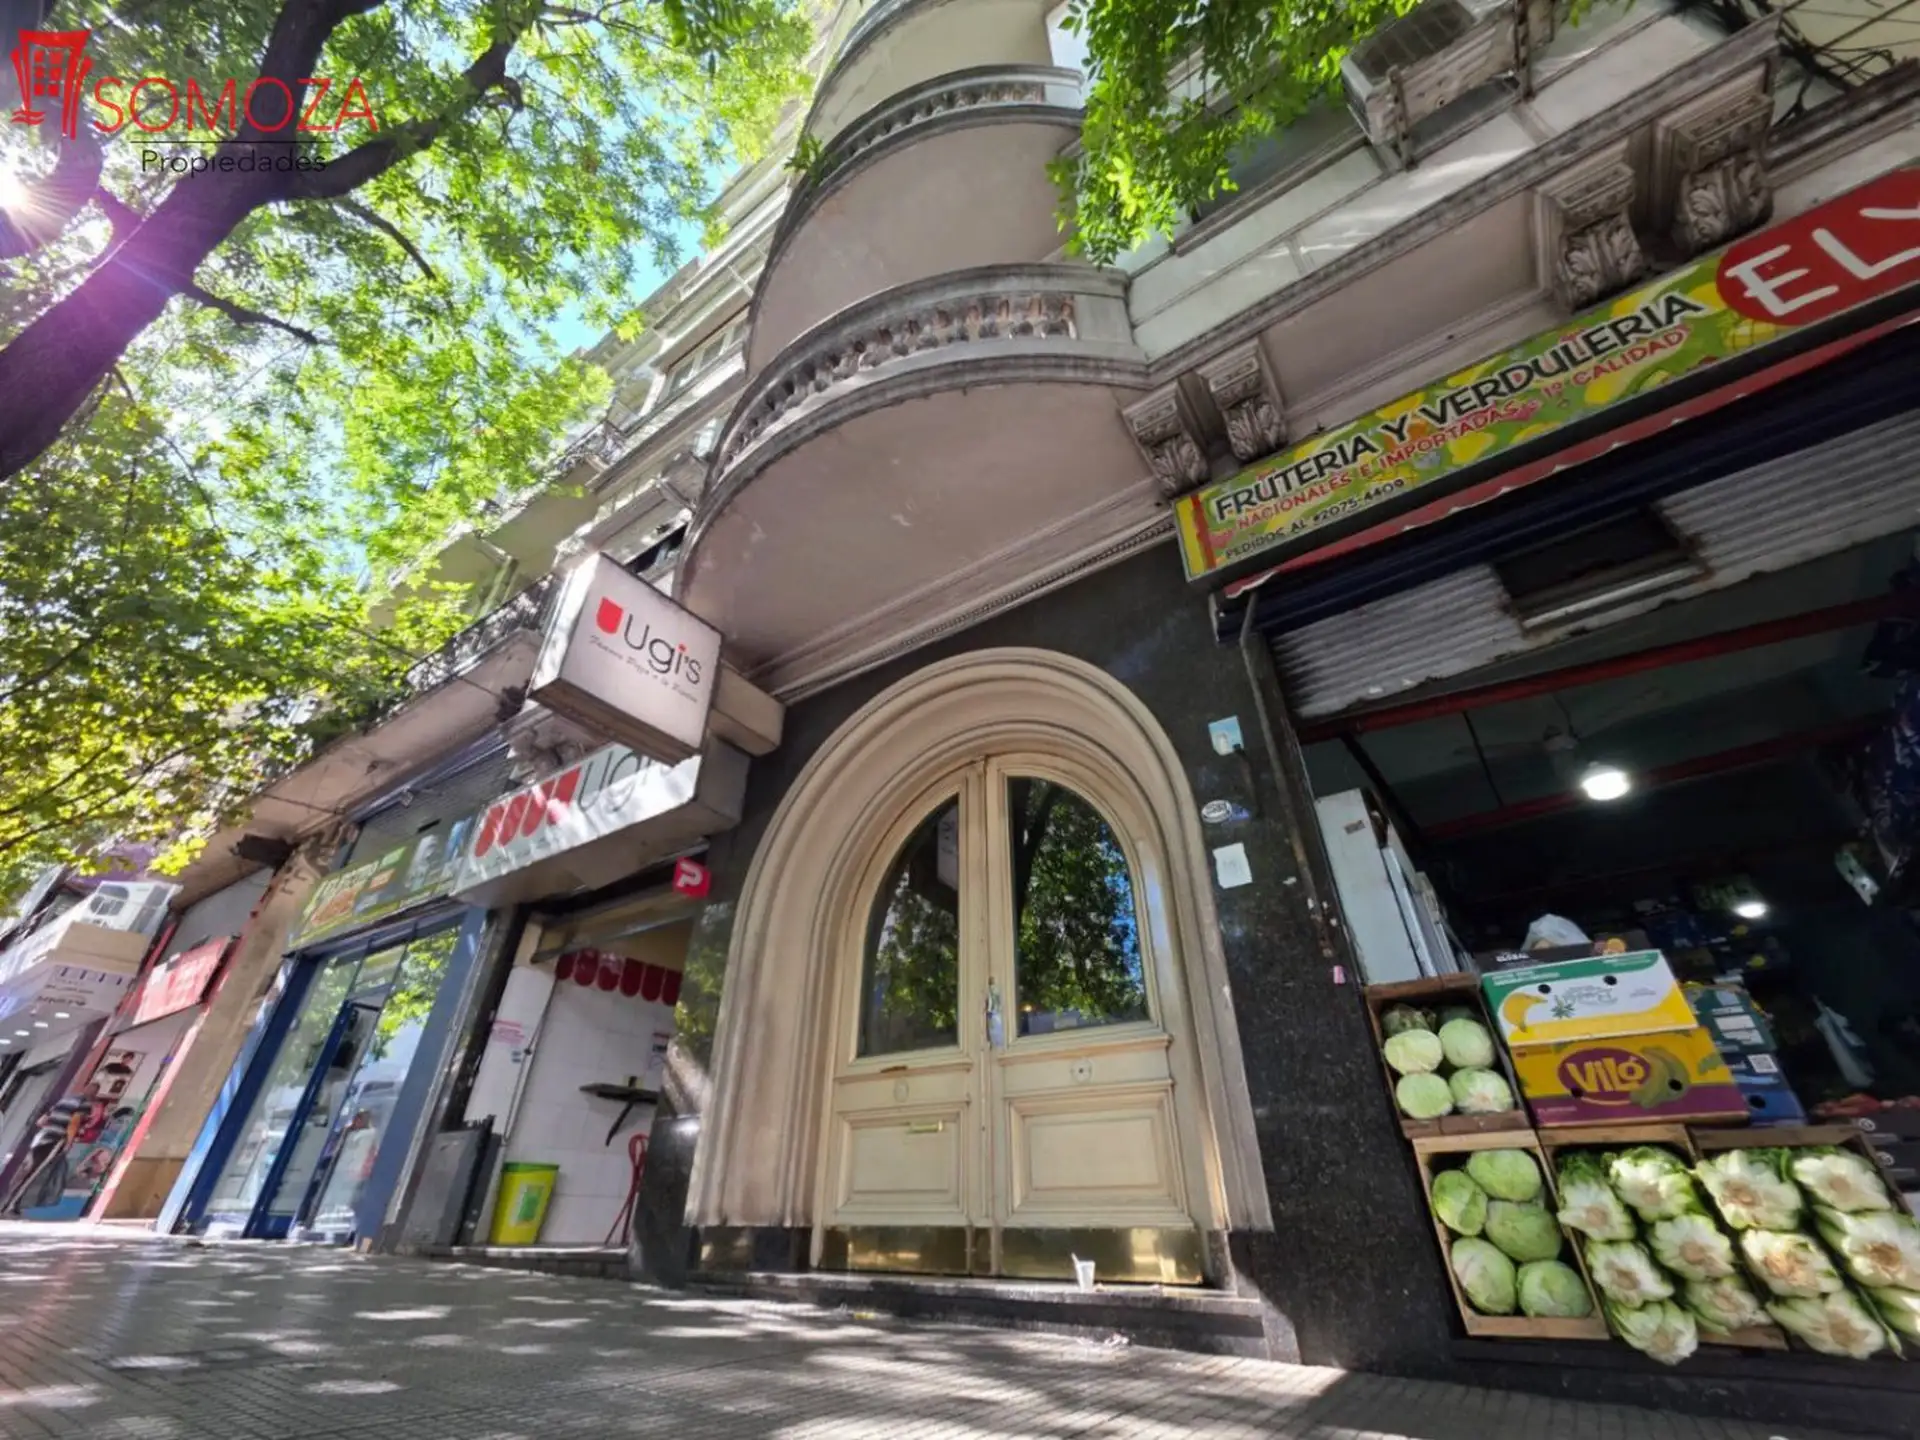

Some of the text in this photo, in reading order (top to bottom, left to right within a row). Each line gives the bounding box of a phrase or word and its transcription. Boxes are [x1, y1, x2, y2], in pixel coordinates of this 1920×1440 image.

[1214, 293, 1705, 522] FRUTERIA Y VERDULERIA
[1237, 471, 1353, 530] NACIONALES
[1360, 462, 1373, 478] E
[1378, 400, 1519, 469] IMPORTADAS
[1571, 329, 1687, 387] CALIDAD
[1291, 518, 1307, 534] AL
[624, 614, 702, 686] Ugi's
